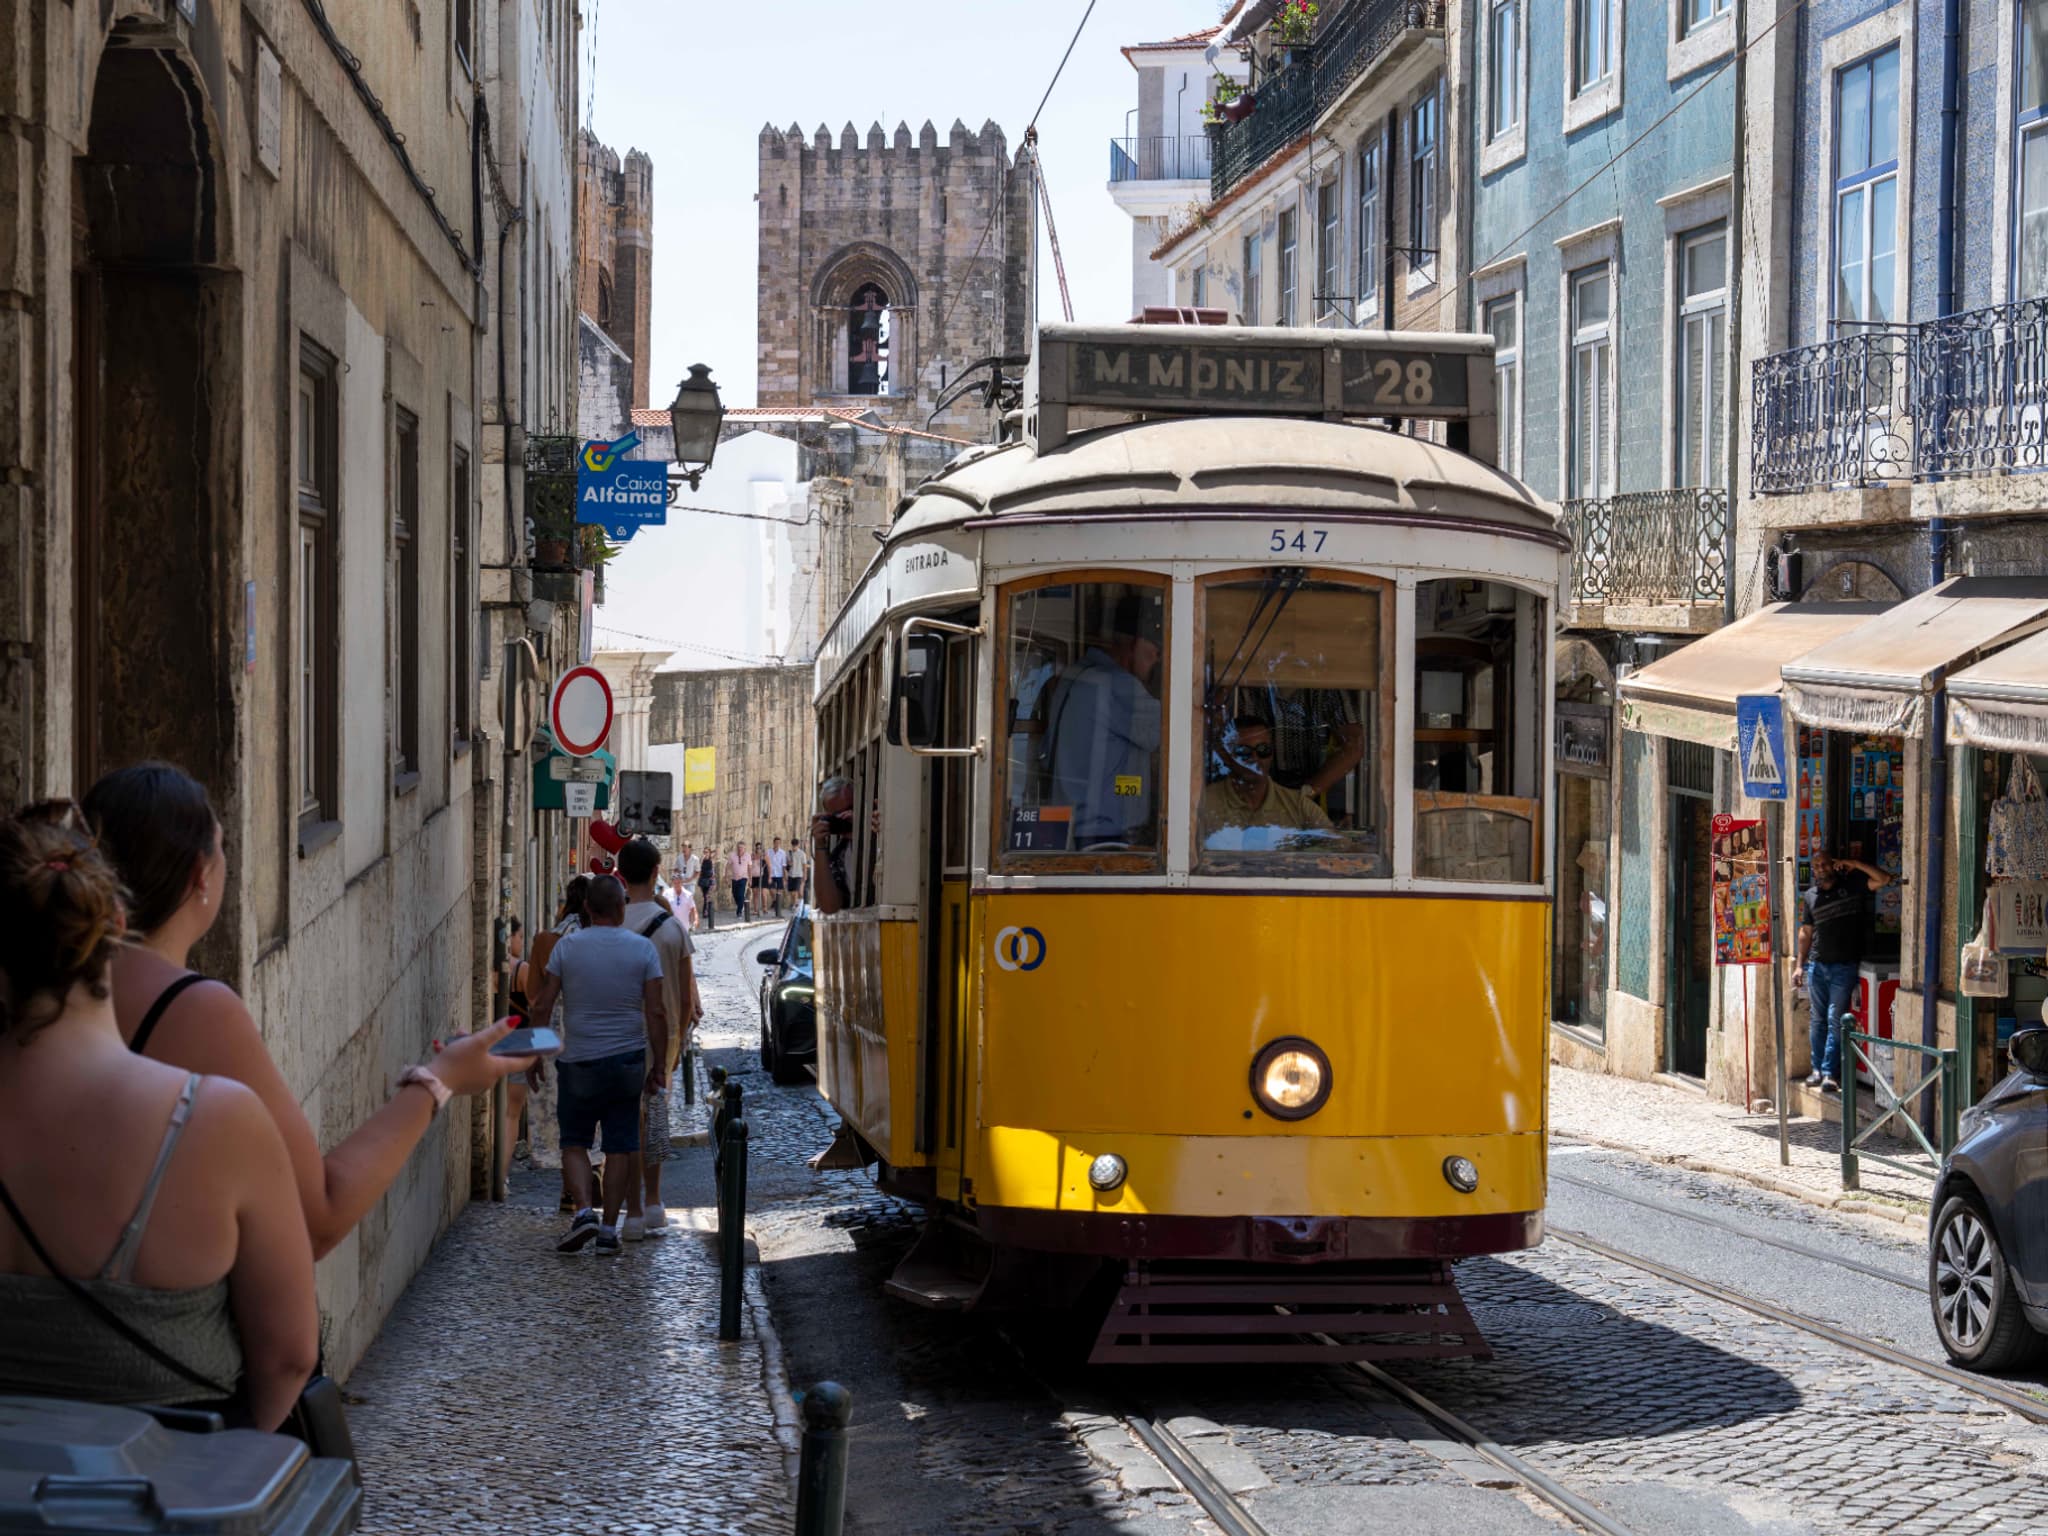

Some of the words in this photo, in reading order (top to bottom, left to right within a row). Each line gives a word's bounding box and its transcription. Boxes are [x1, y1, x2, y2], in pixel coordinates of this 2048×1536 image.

[1094, 350, 1138, 384] M.
[1150, 353, 1305, 394] MONIZ
[1374, 359, 1433, 405] 28
[615, 473, 663, 491] Caixa
[583, 486, 662, 504] Alfama
[1270, 529, 1328, 552] 547
[905, 550, 949, 574] ENTRADA
[1974, 710, 2029, 741] MERCADOR
[1016, 811, 1038, 822] 28E
[1015, 832, 1033, 848] 11
